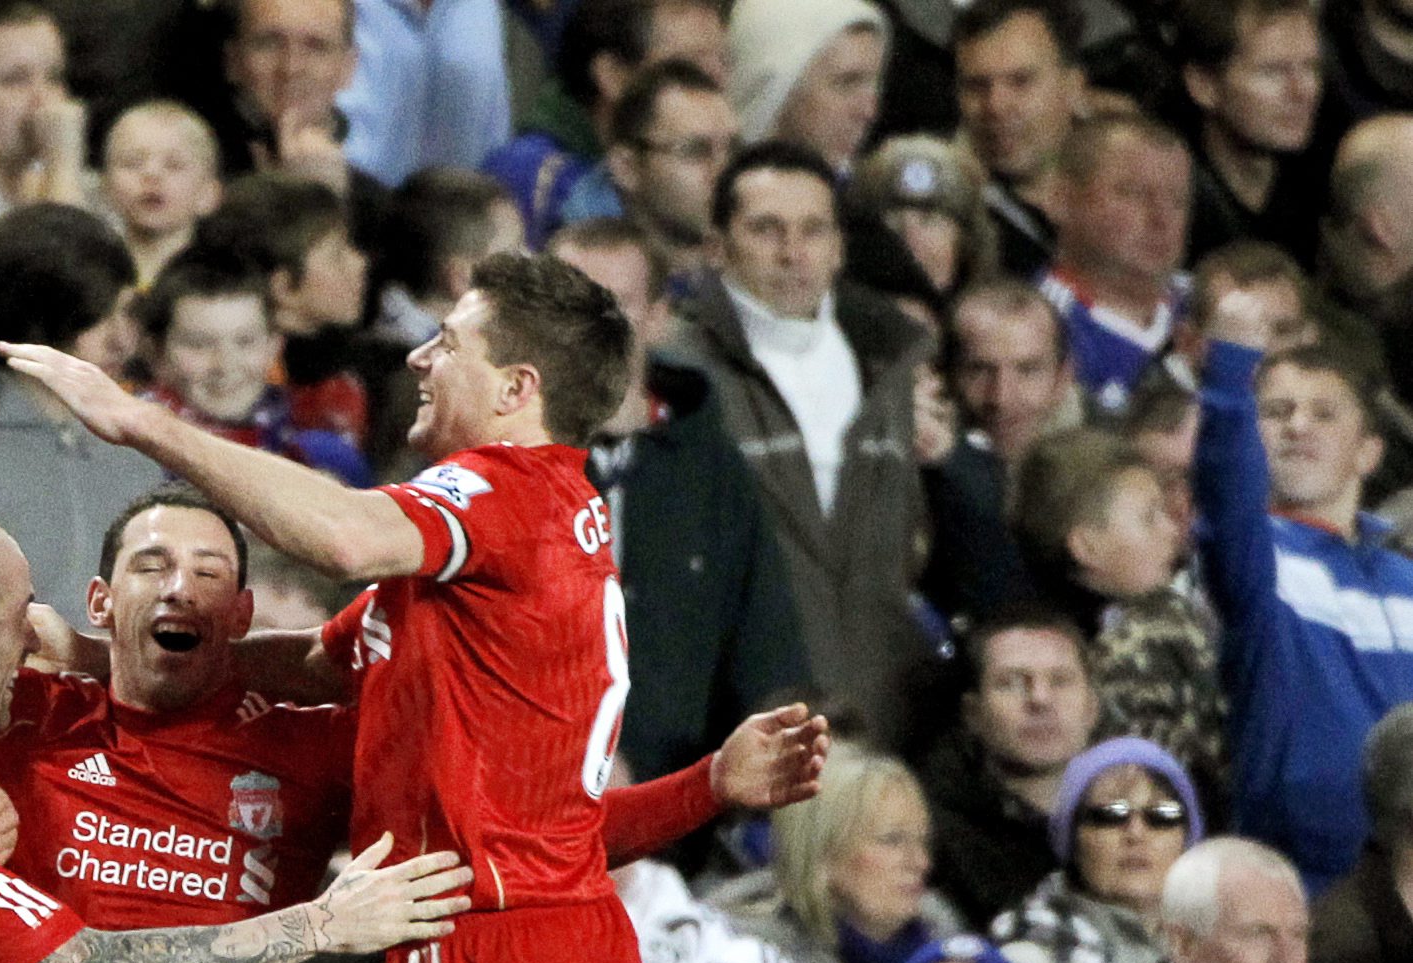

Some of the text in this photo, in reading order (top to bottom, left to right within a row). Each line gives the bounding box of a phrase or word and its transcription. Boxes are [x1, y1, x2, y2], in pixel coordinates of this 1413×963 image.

[68, 768, 117, 787] adidas
[73, 811, 233, 865] Standard
[56, 847, 228, 901] Chartered
